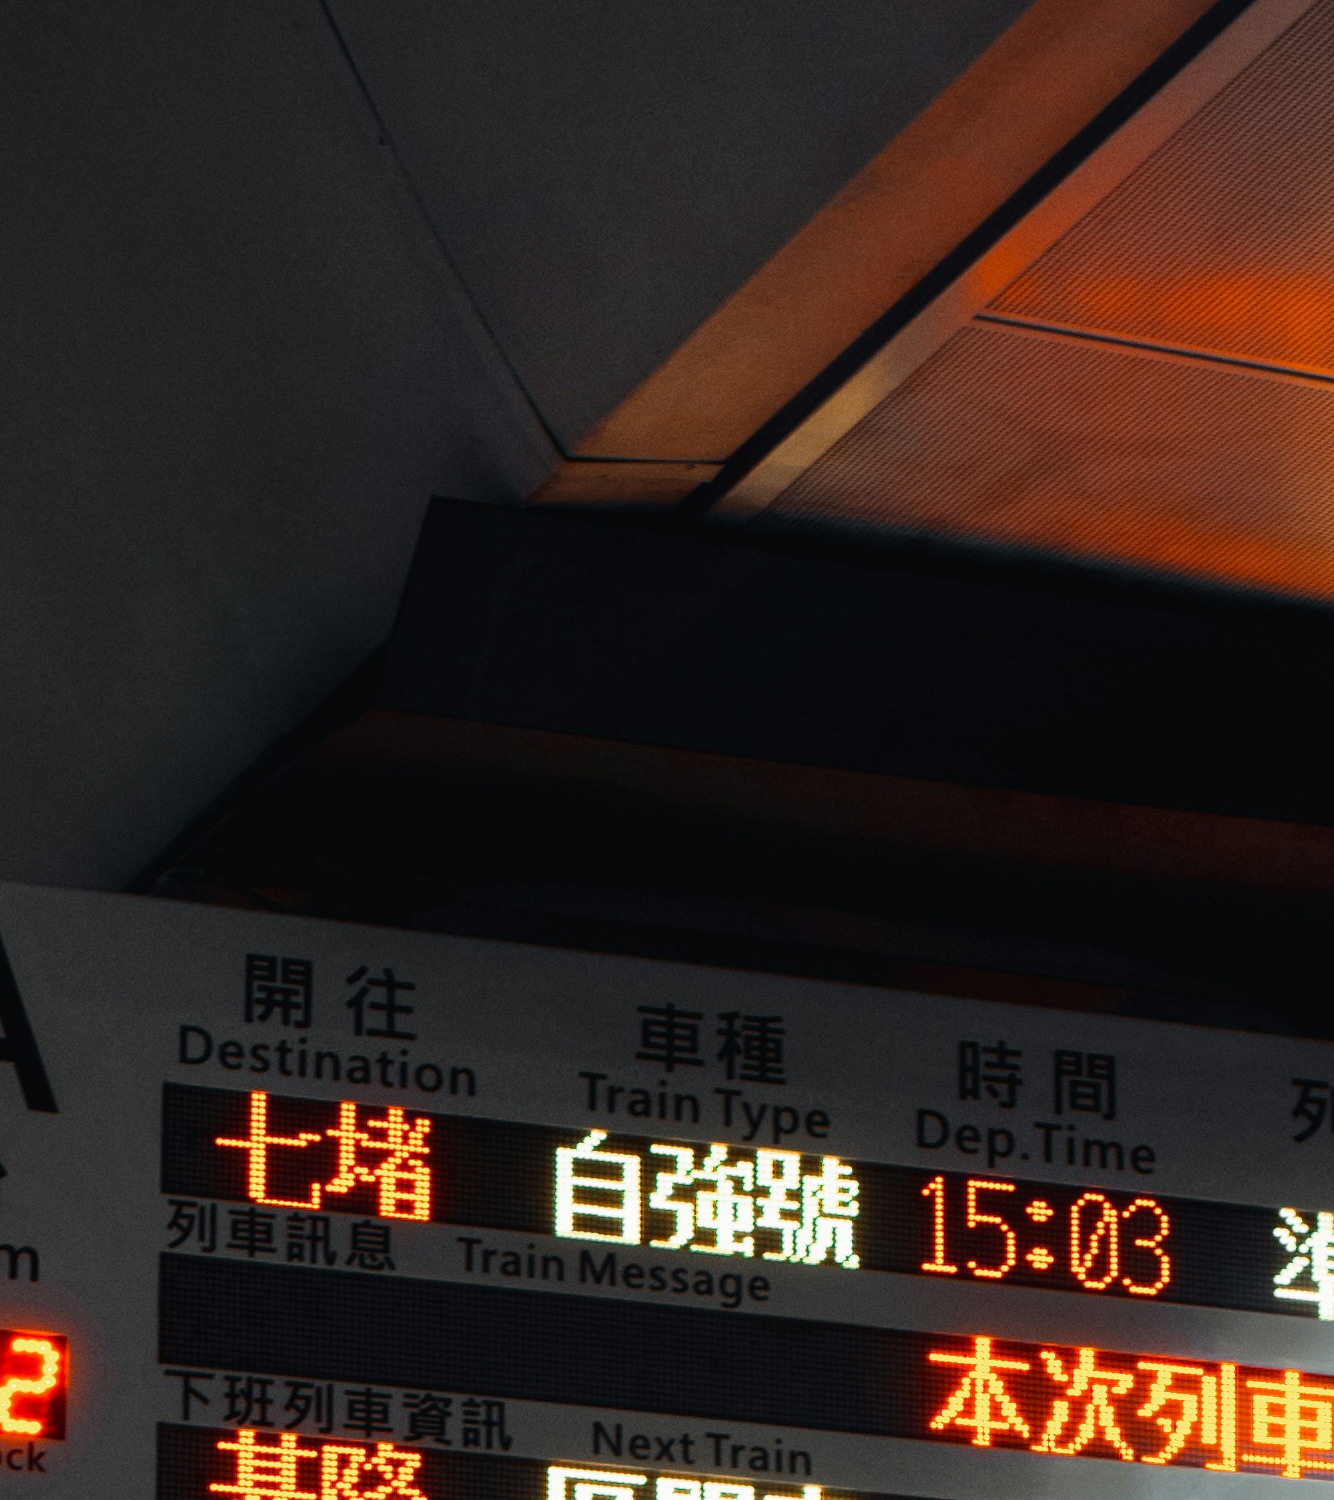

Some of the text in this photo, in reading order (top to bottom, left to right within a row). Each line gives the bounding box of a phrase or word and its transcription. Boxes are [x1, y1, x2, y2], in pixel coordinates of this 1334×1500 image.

[242, 953, 418, 1042] 開往
[177, 1024, 478, 1098] Destination
[635, 1003, 787, 1086] 車種
[958, 1039, 1118, 1120] 時間
[578, 1071, 831, 1144] Train Type
[915, 1109, 1157, 1176] Dep.Time
[215, 1090, 431, 1222] 七堵
[166, 1200, 396, 1272] 列車訊息
[554, 1129, 861, 1270] 自強號
[920, 1176, 1171, 1297] 15:03
[457, 1237, 771, 1308] Train Message
[164, 1369, 513, 1452] 下班列車資訊
[592, 1422, 813, 1476] Next Train
